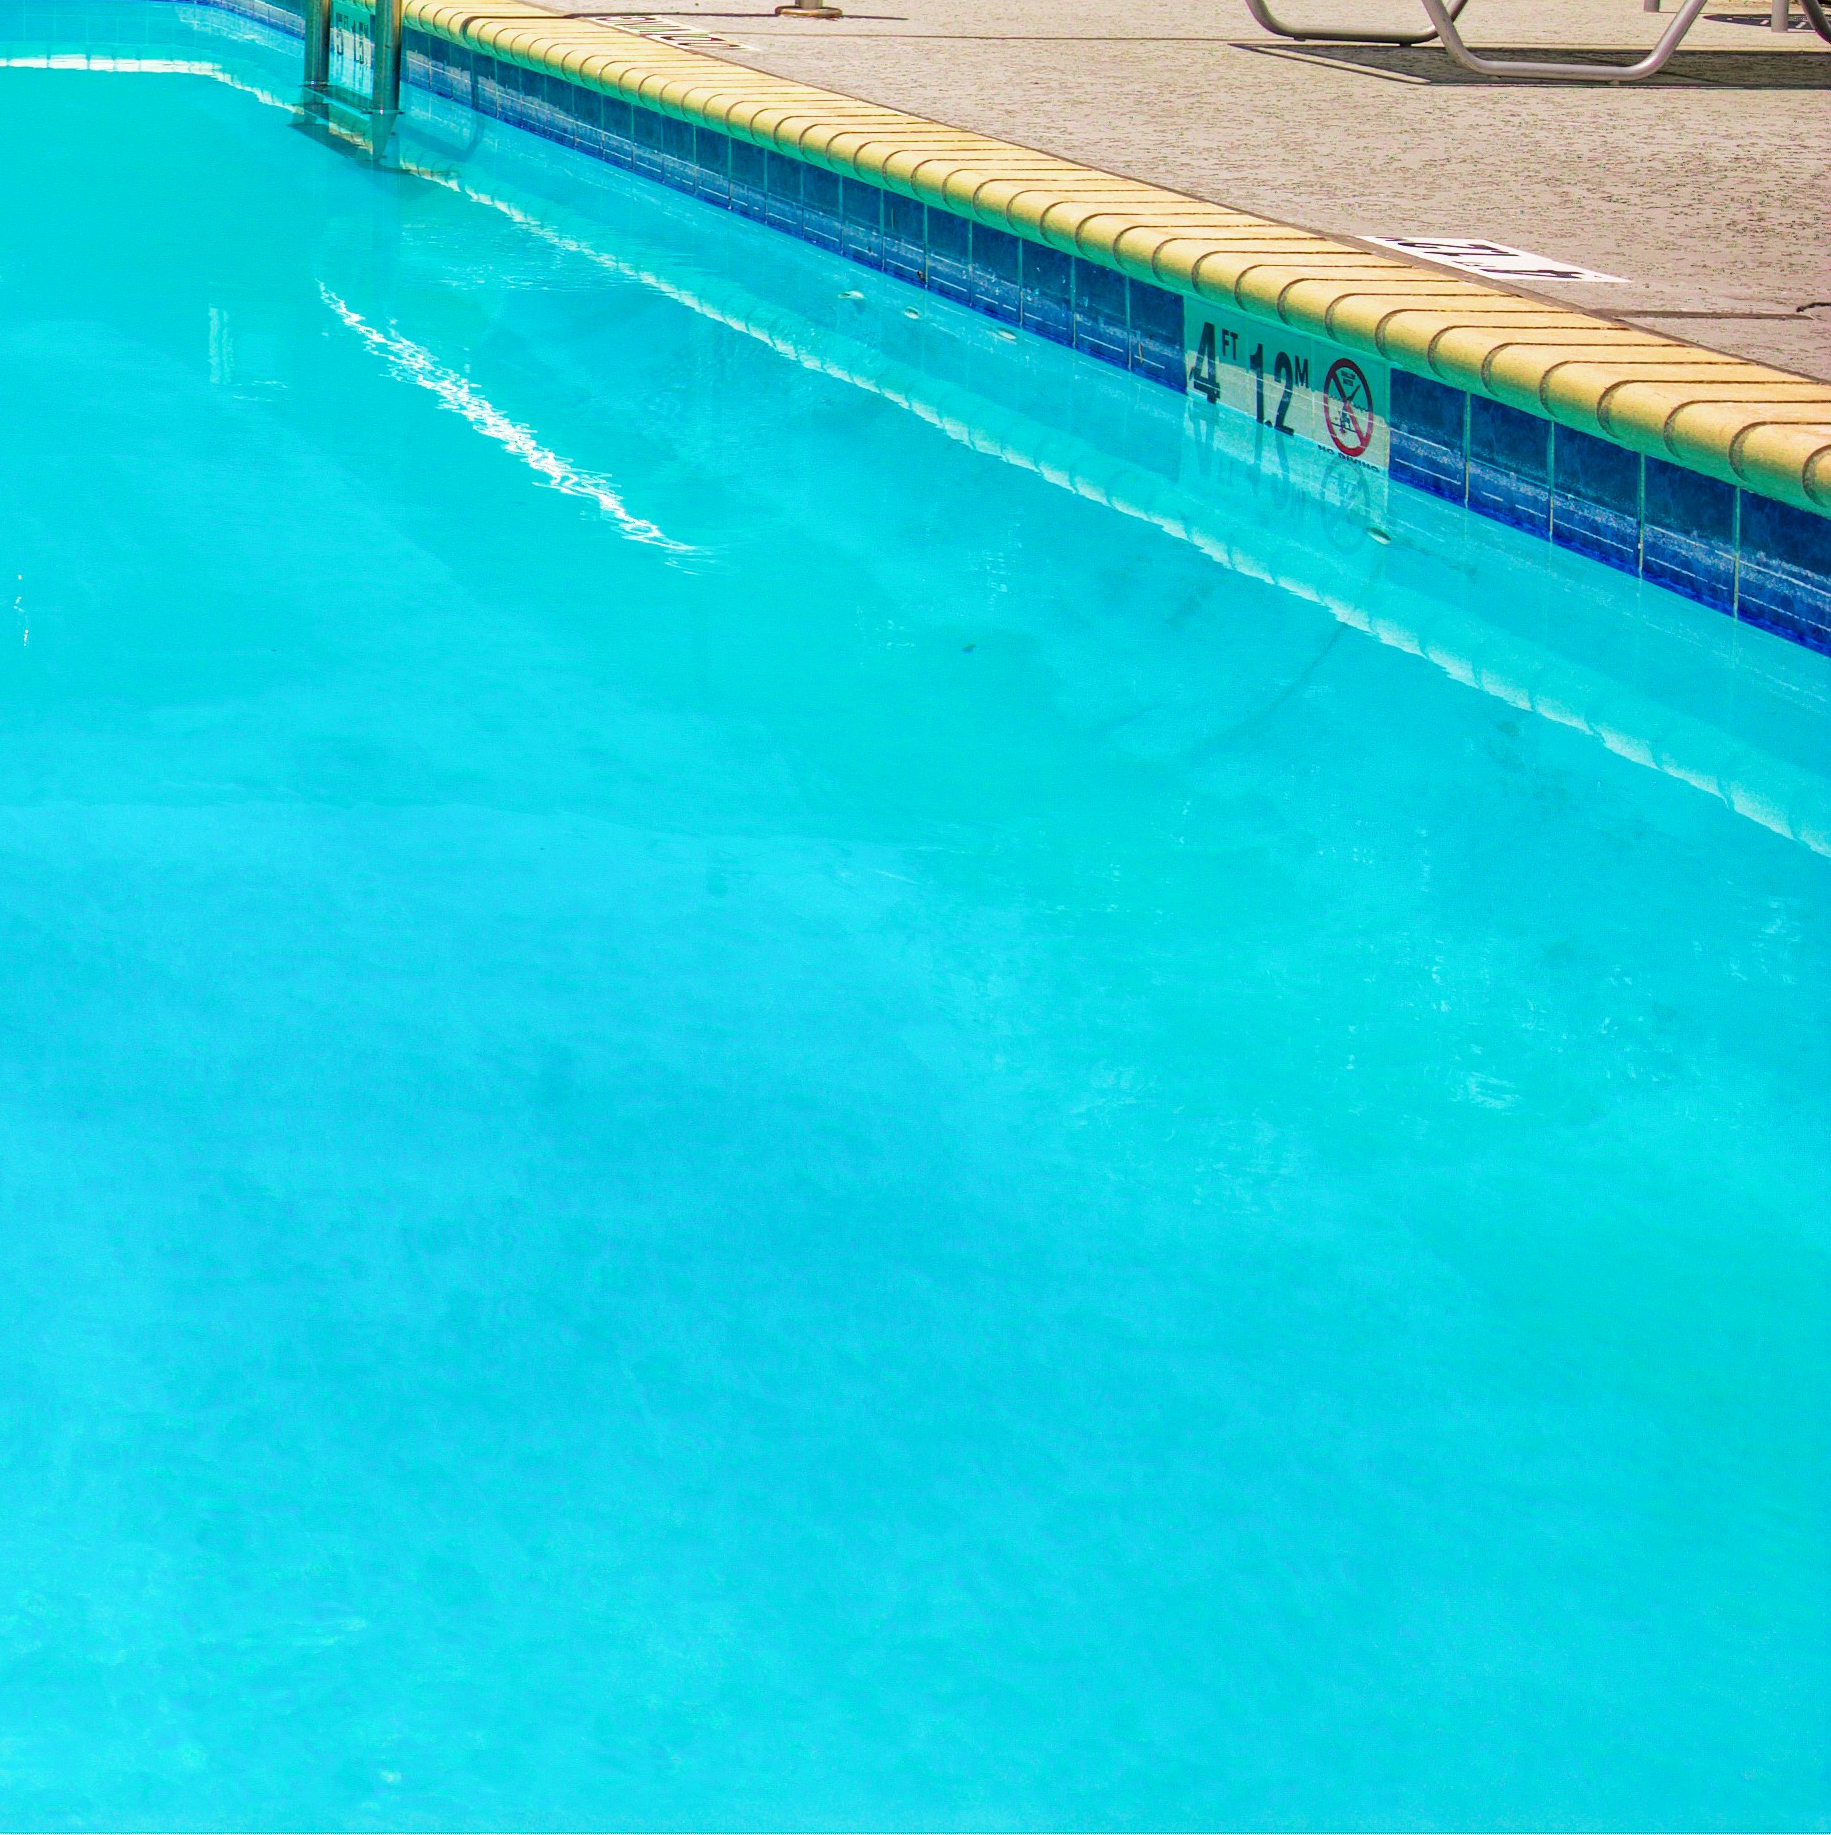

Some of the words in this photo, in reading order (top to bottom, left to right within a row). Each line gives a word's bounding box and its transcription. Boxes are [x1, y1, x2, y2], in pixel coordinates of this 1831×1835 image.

[1193, 321, 1221, 405] 4
[1221, 328, 1239, 361] FT
[1249, 343, 1295, 437] 1.2
[1294, 355, 1309, 390] M
